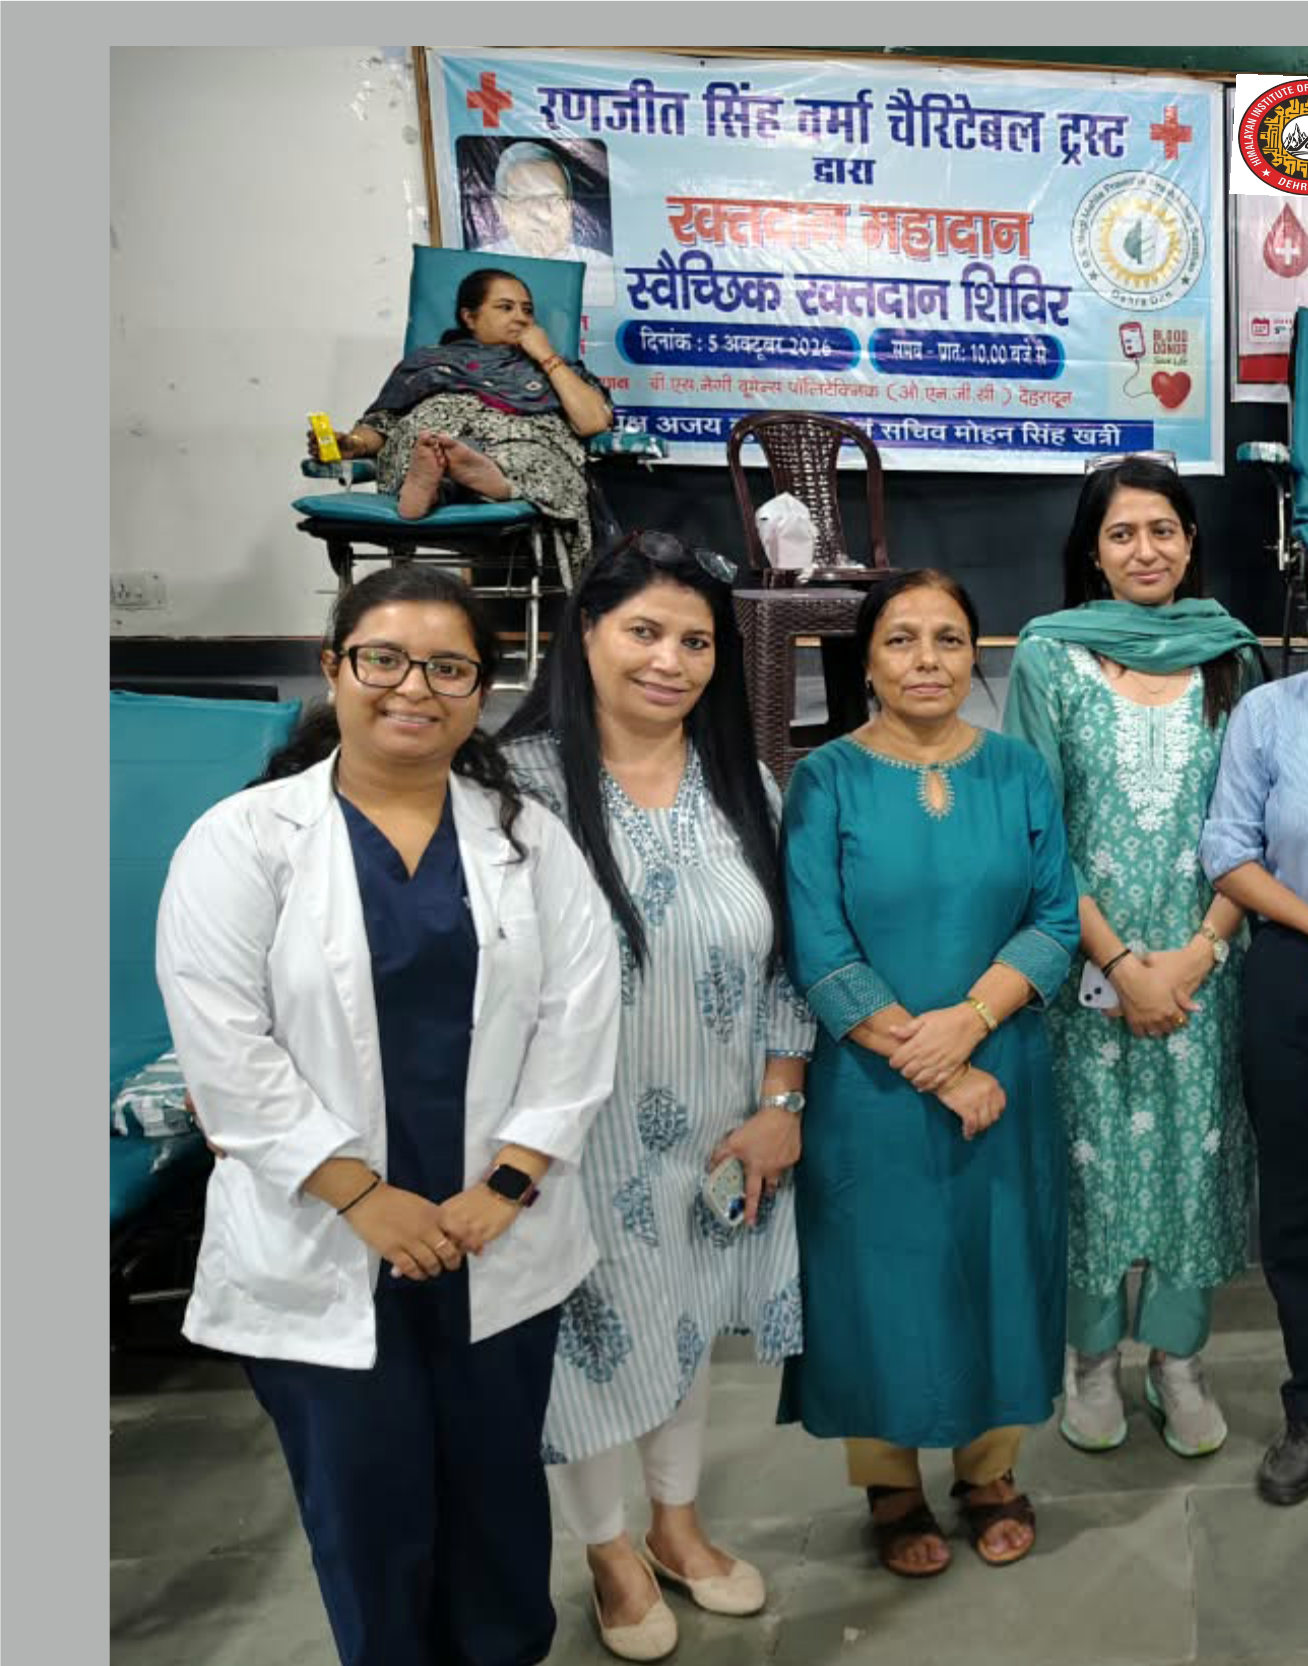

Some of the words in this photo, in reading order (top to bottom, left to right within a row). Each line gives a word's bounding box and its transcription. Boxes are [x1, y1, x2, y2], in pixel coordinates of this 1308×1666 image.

[538, 78, 690, 136] रणजीत
[703, 82, 784, 138] सिंह
[795, 88, 873, 144] वर्मा
[886, 88, 1045, 153] चैरिटेबल
[1058, 115, 1129, 165] ट्रस्ट
[812, 158, 876, 185] द्वारा
[666, 196, 849, 247] रक्तदान
[860, 203, 1033, 261] महादान
[624, 249, 784, 313] स्वैच्छिक
[794, 274, 950, 320] रक्तदान
[960, 262, 1072, 326] शिविर
[640, 326, 691, 354] दिनांक
[708, 336, 718, 352] 5
[656, 416, 722, 435] अजय
[881, 417, 945, 441] सचिव
[954, 418, 1014, 444] मोहन
[1022, 420, 1066, 446] सिंह
[1073, 422, 1121, 447] खत्री
